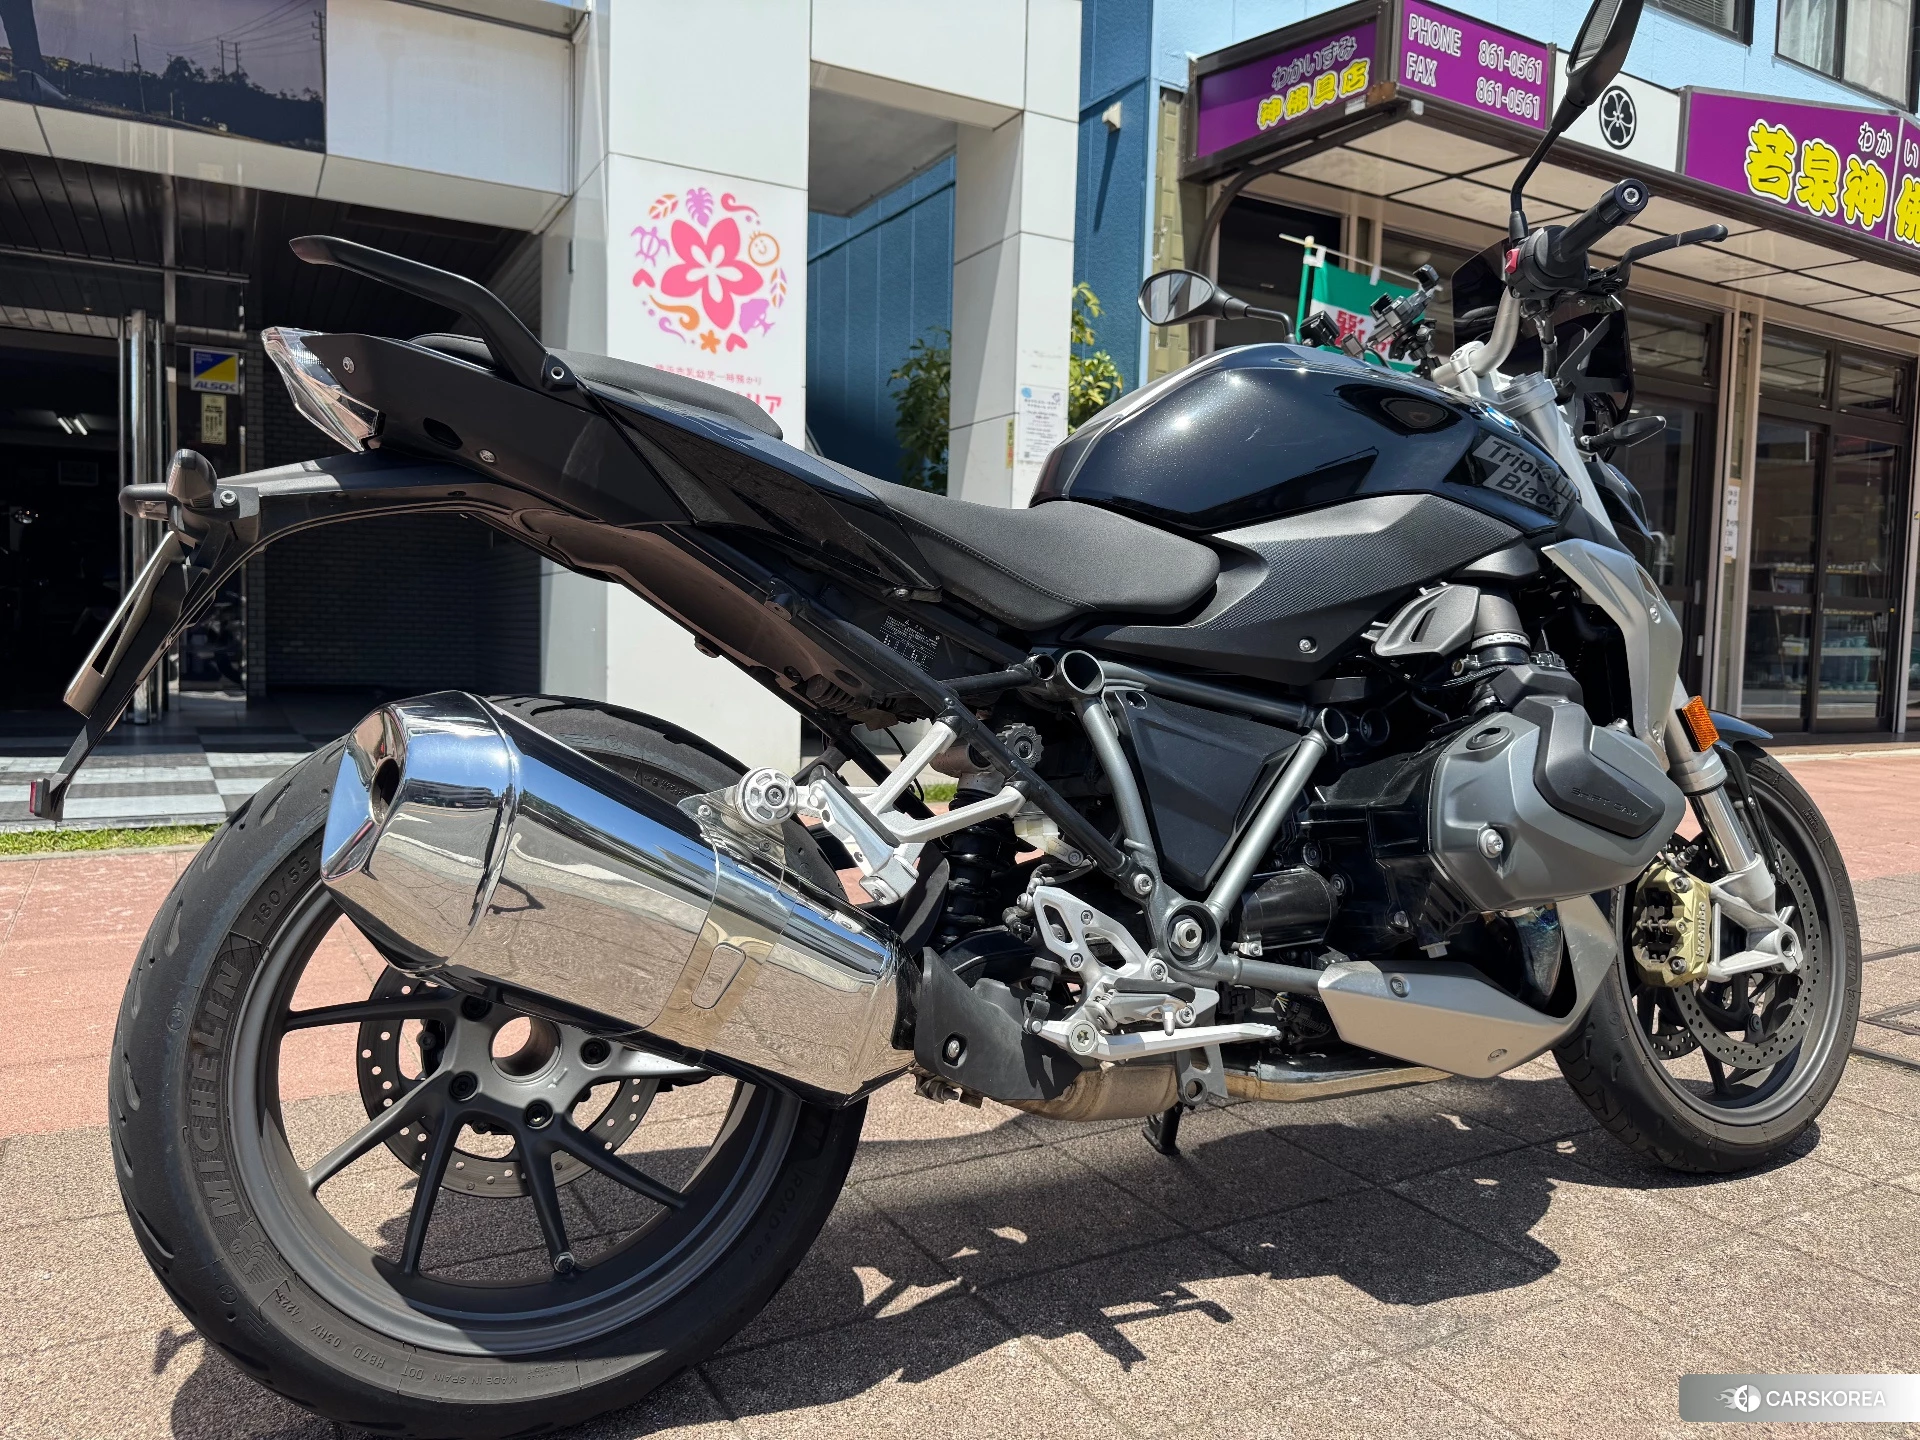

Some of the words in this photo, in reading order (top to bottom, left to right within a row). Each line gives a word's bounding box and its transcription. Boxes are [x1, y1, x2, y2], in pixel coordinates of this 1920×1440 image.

[1271, 35, 1358, 91] わかいずみ
[1408, 13, 1462, 57] PHONE
[1478, 39, 1543, 85] 861-0561
[1405, 51, 1438, 88] FAX
[1475, 76, 1541, 121] 861-0561
[195, 380, 236, 392] ALSOK
[1496, 472, 1561, 512] Black
[1571, 786, 1611, 807] SHIFT
[1613, 802, 1639, 818] CAM
[252, 856, 312, 927] 180/55
[1695, 901, 1707, 958] brembo
[191, 960, 243, 1218] MICHELIN
[768, 1172, 804, 1230] ROAD
[401, 1365, 425, 1381] DOT
[433, 1372, 468, 1387] SPAIN
[471, 1375, 483, 1386] IN
[486, 1374, 519, 1387] MADE
